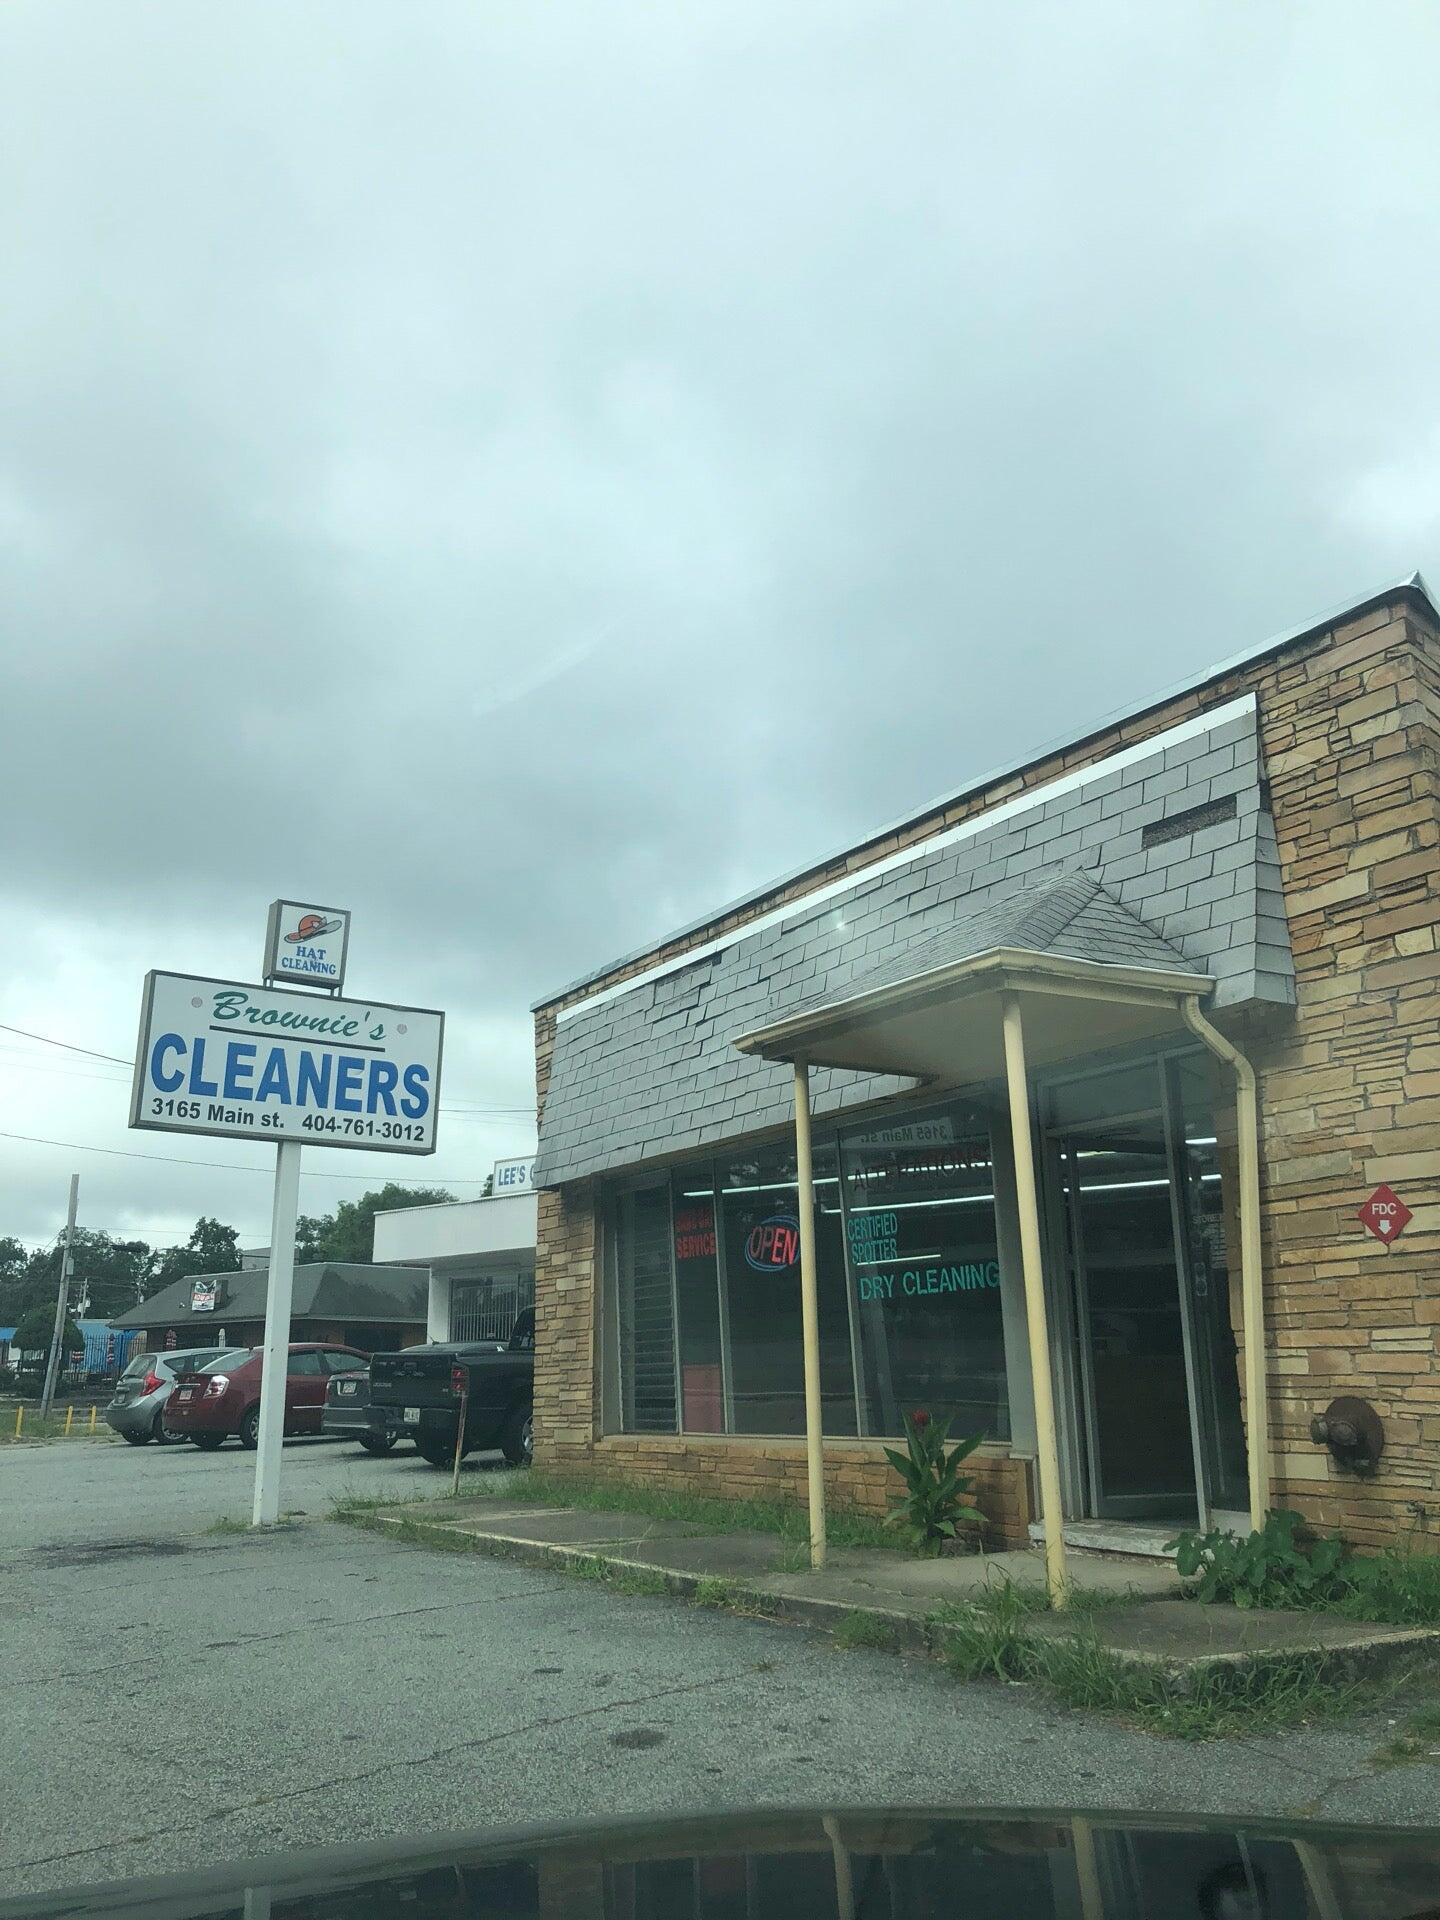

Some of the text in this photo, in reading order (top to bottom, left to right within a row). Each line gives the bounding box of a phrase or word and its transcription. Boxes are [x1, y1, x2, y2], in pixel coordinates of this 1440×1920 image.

[281, 957, 337, 975] CLEANING
[296, 946, 326, 960] HAT
[212, 991, 386, 1040] Brownie's
[151, 1033, 430, 1119] CLEANERS
[152, 1097, 425, 1142] 3165 Main st. 404-761-3012
[498, 1165, 526, 1186] LEE'S
[1371, 1203, 1397, 1215] FDC
[847, 1213, 898, 1241] CERTIFIED
[676, 1232, 717, 1260] SERVICE
[751, 1226, 798, 1265] OPEN
[852, 1238, 899, 1264] SPOTTER
[860, 1262, 1000, 1300] DRY CLEANING
